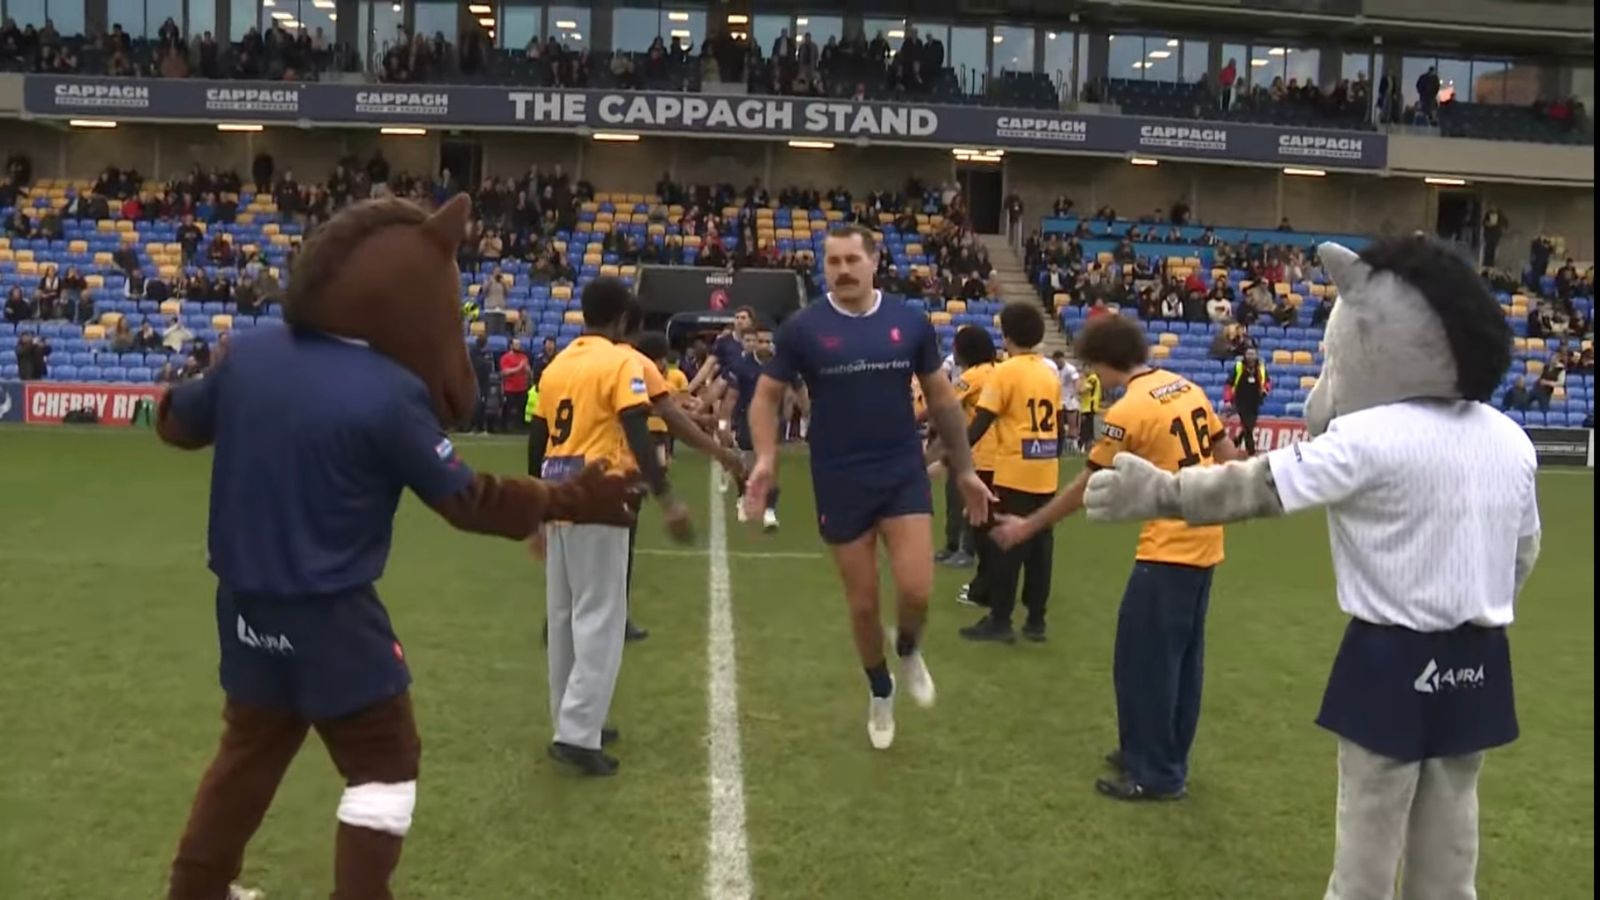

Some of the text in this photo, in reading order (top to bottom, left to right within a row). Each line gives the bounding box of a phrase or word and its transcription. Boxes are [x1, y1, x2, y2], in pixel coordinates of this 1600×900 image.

[54, 84, 149, 98] CAPPAGH
[206, 88, 299, 102] CAPPAGH
[355, 92, 449, 106] CAPPAGH
[508, 92, 938, 136] THE CAPPAGH STAND
[996, 117, 1087, 132] CAPPAGH
[1140, 125, 1227, 141] CAPPAGH
[1278, 134, 1363, 150] CAPPAGH
[32, 392, 155, 418] CHERRY RE
[550, 398, 574, 446] 9
[1026, 398, 1054, 432] 12
[1170, 406, 1212, 467] 16
